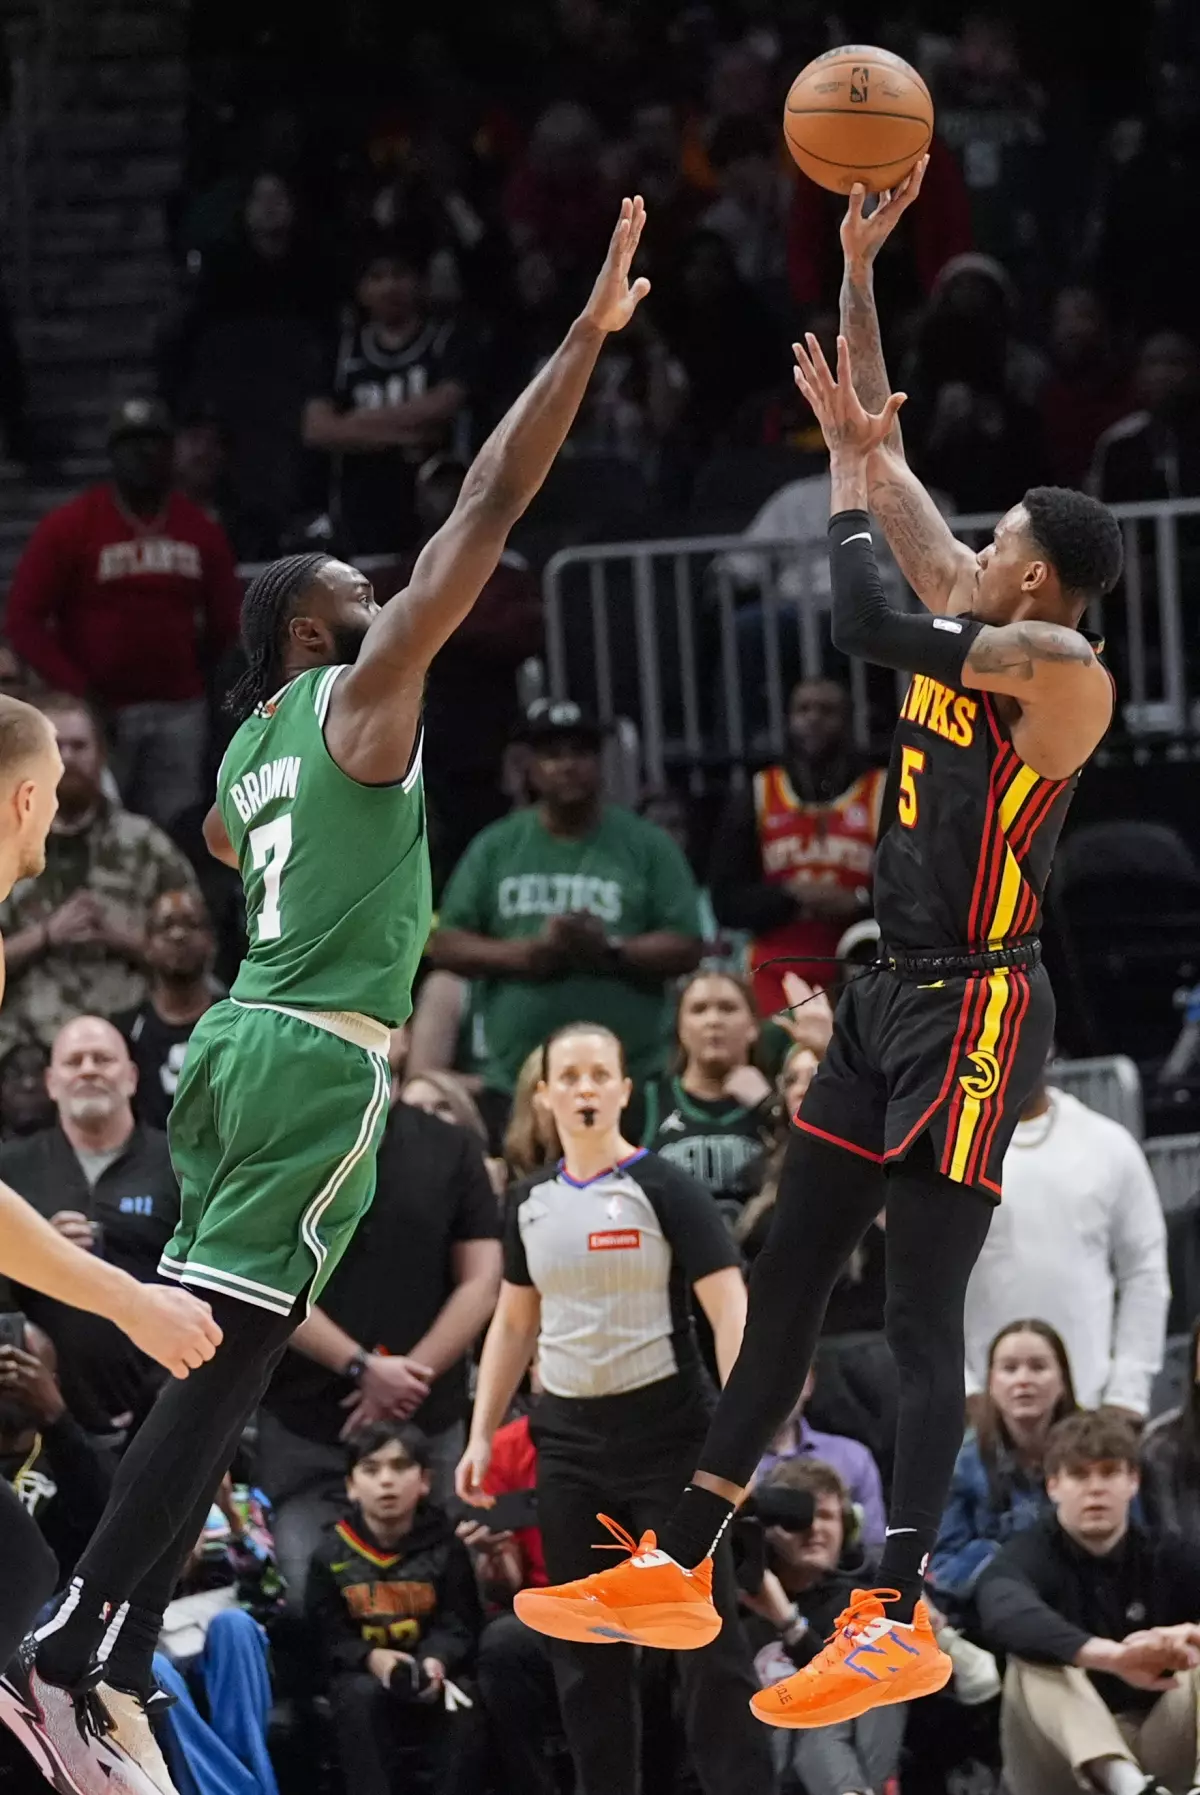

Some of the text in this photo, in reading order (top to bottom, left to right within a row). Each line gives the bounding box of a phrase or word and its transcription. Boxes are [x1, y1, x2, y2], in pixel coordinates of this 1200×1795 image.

[230, 756, 301, 824] BROWN
[898, 745, 925, 829] 5
[249, 813, 292, 940] 7
[499, 872, 621, 921] CELTICS
